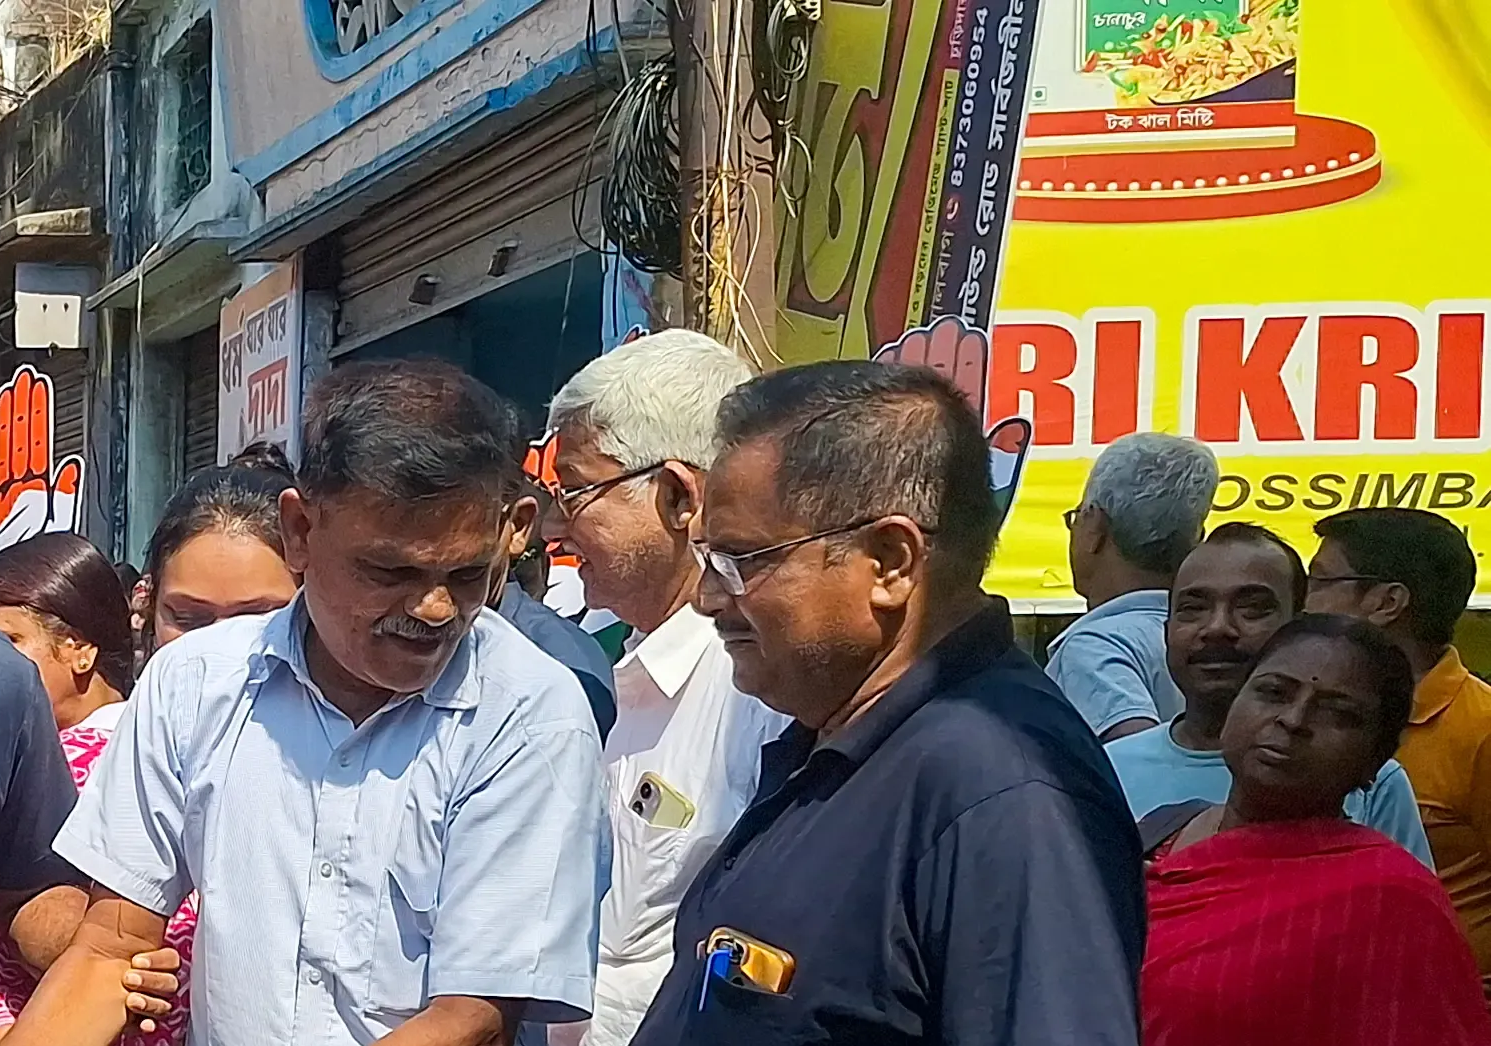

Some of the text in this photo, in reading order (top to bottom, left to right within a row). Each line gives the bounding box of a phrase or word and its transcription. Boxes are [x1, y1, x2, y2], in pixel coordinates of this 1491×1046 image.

[1093, 11, 1146, 31] চানাচুর
[950, 7, 989, 187] 8373060954
[1105, 107, 1215, 130] টক ঝাল মিষ্টি
[958, 245, 987, 325] াউন্ড
[975, 160, 1000, 237] রোড
[247, 356, 288, 434] দাদা
[987, 313, 1485, 446] RI KRI
[1212, 472, 1491, 512] OSSIMB
